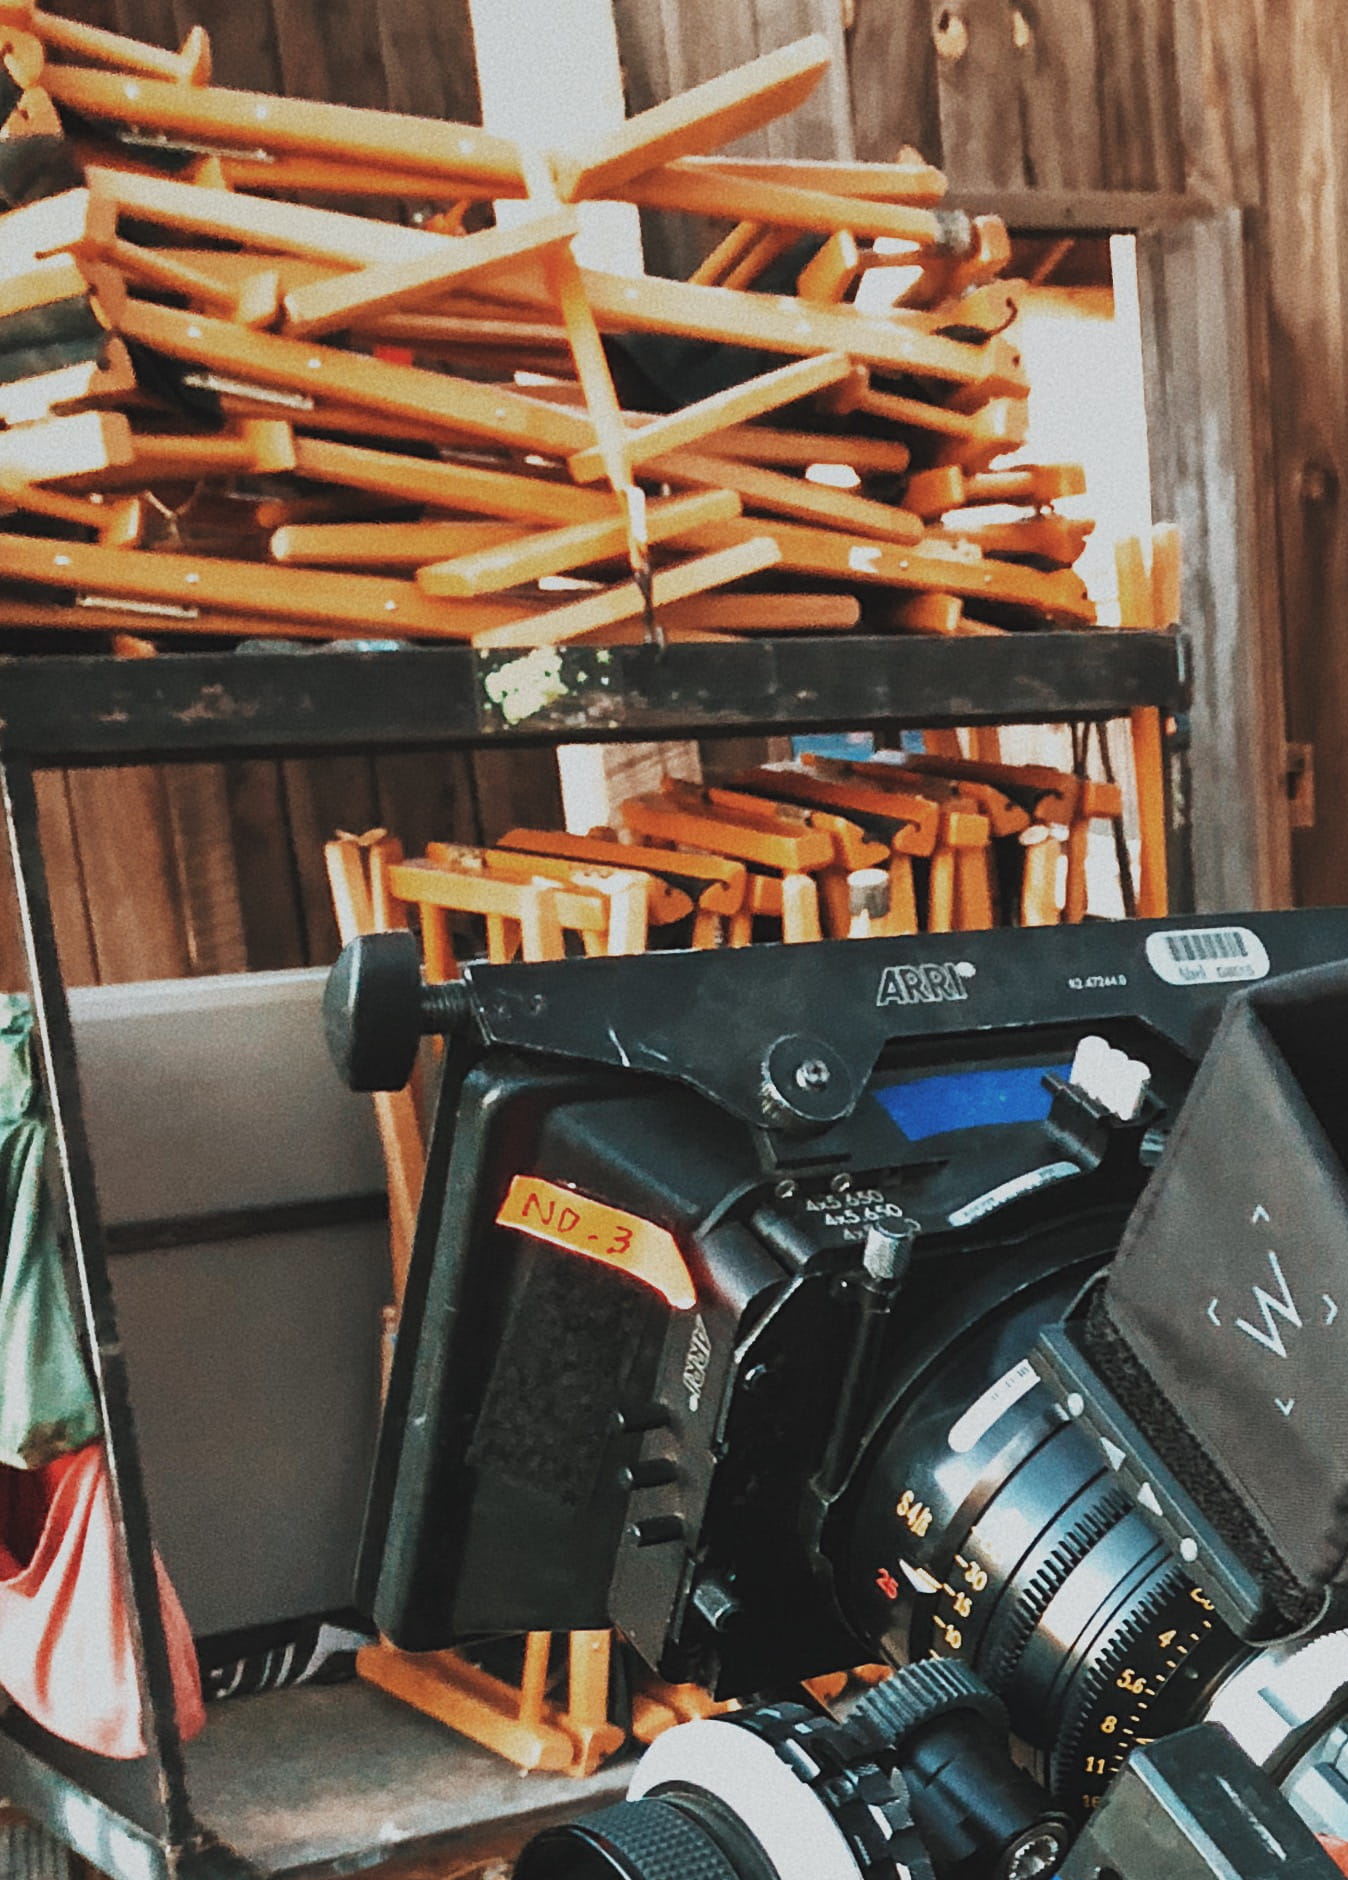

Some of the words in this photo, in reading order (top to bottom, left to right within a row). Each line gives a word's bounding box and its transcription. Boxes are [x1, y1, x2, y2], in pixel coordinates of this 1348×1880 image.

[876, 962, 969, 1007] ARRI
[1235, 1250, 1304, 1359] W
[682, 1312, 712, 1400] ARRI
[1157, 1629, 1177, 1648] 4
[1115, 1667, 1148, 1695] 5.6
[1100, 1715, 1118, 1734] 8
[1085, 1756, 1106, 1775] 11
